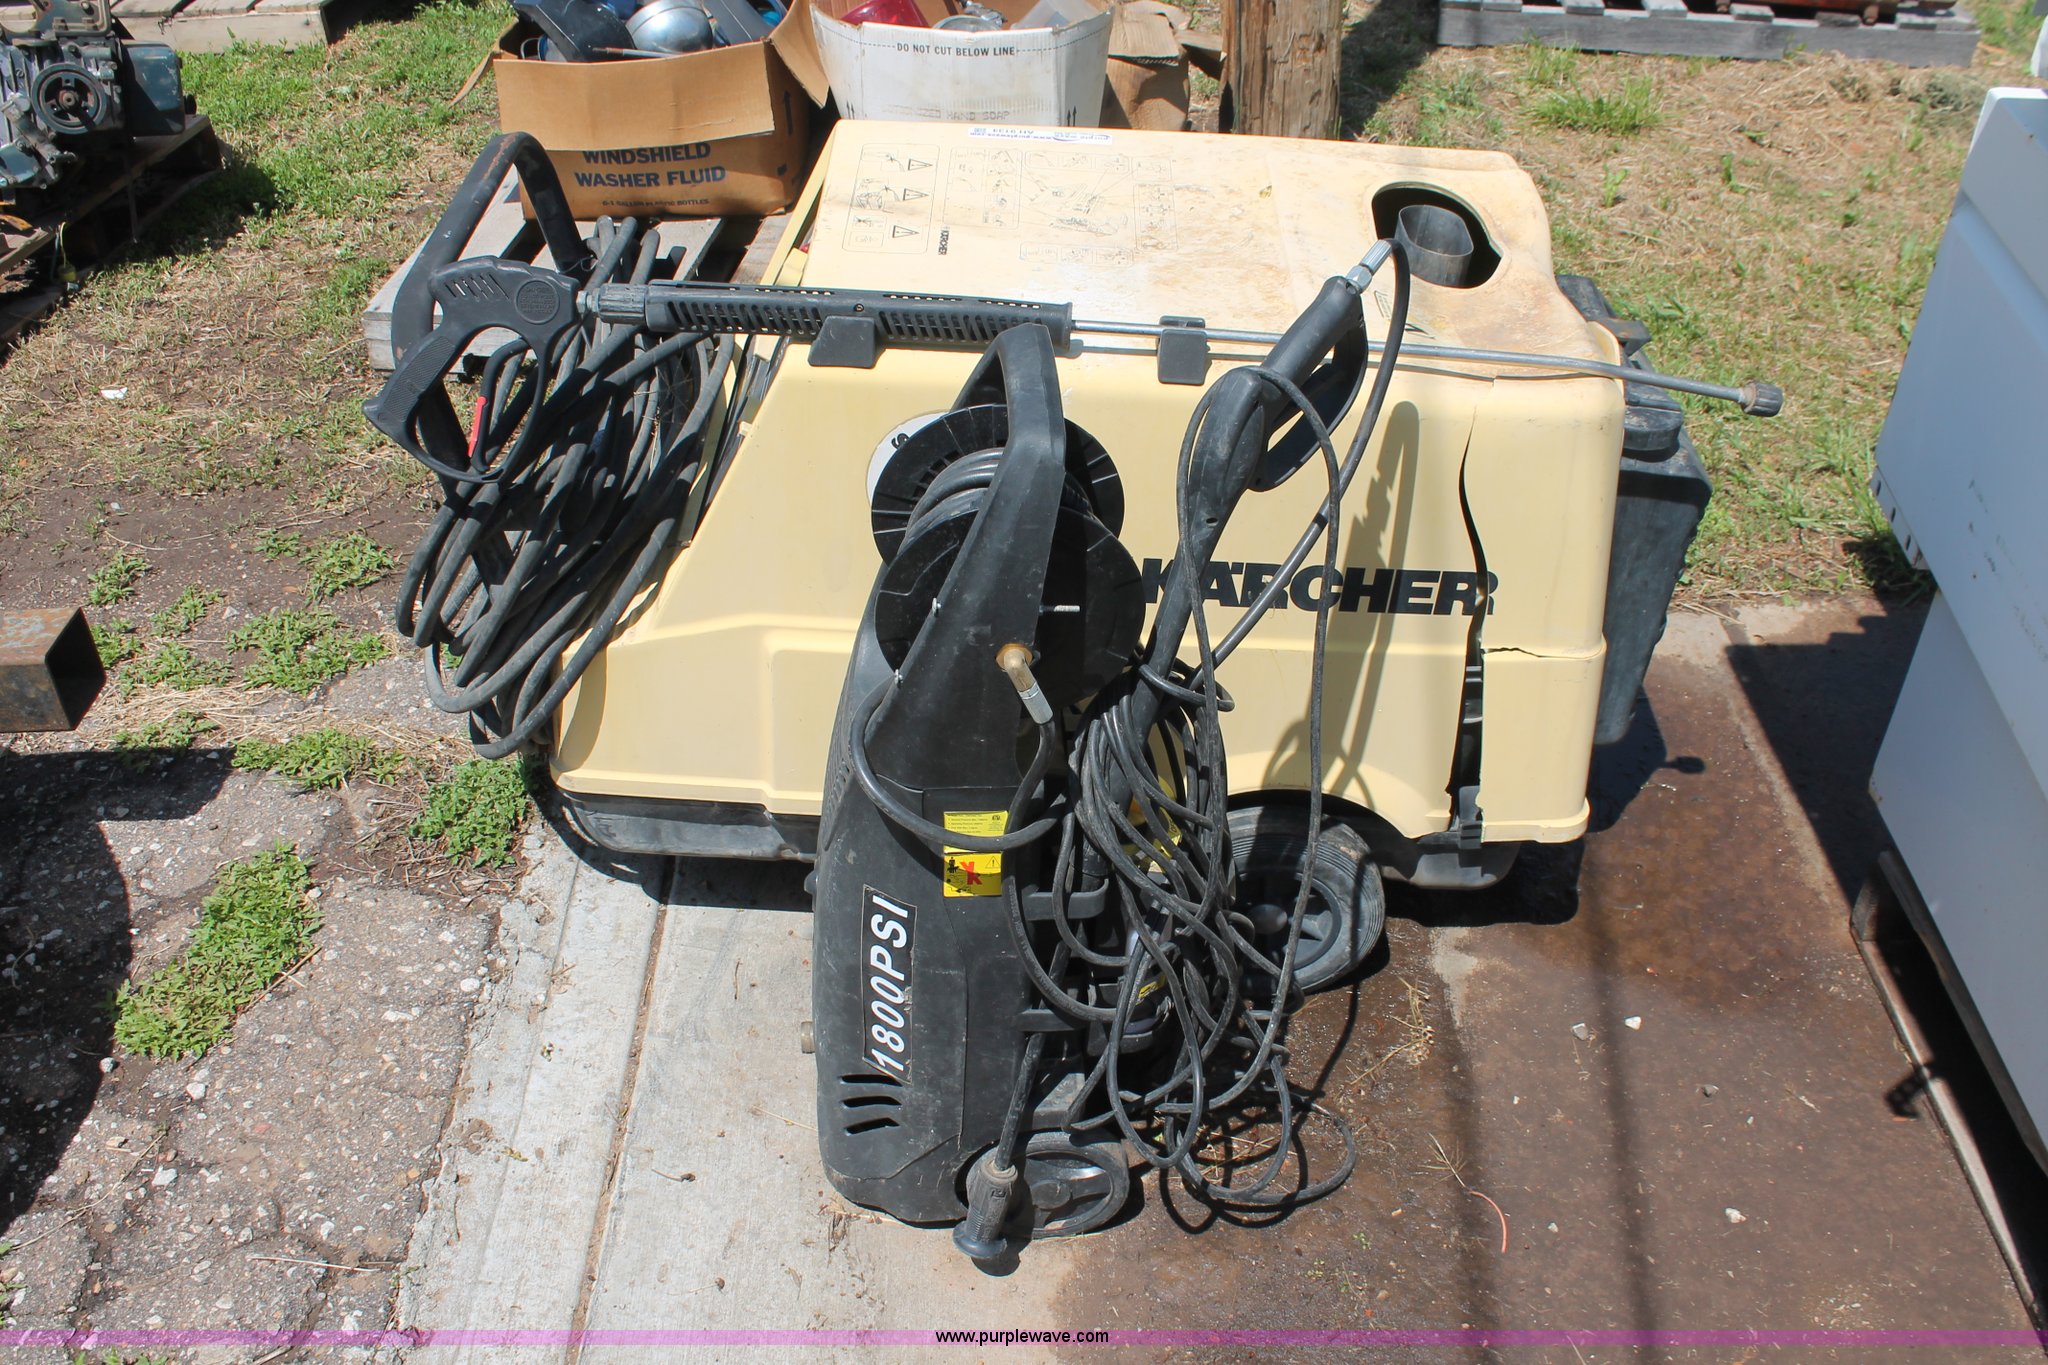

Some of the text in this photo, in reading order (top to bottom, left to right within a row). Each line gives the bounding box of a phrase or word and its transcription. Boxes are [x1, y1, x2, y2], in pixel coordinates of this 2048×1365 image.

[896, 42, 1015, 57] DO NOT CUT BELOW LINE
[582, 142, 711, 165] WINDSHIELD
[574, 165, 726, 188] WASHER FLUID
[870, 895, 909, 1072] 1800PSI
